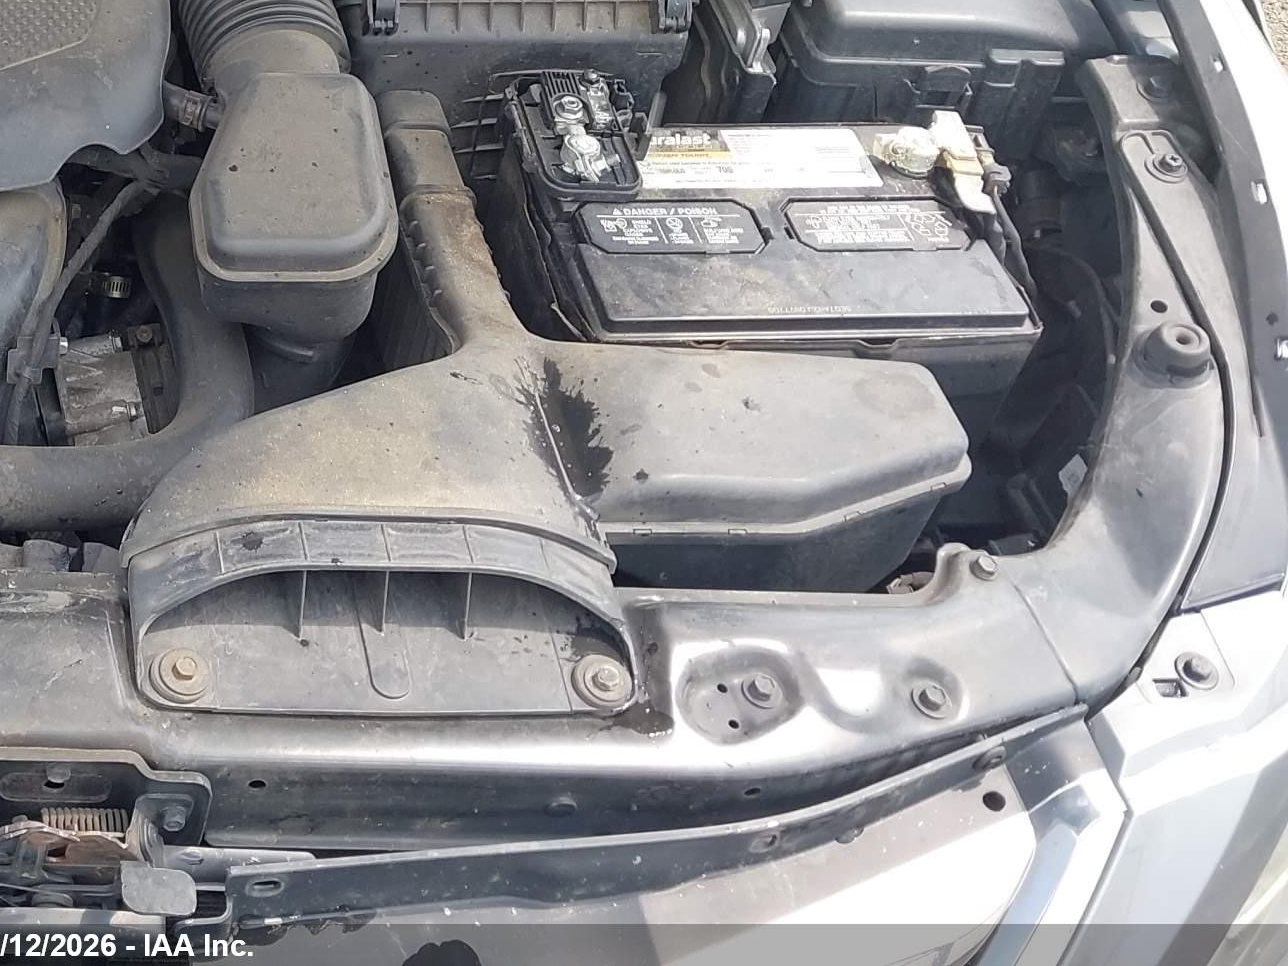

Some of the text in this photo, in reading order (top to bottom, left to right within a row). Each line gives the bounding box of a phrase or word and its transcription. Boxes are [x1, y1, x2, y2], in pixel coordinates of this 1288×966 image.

[649, 131, 712, 145] uralast
[623, 208, 668, 216] DANGER
[677, 207, 718, 215] POISON
